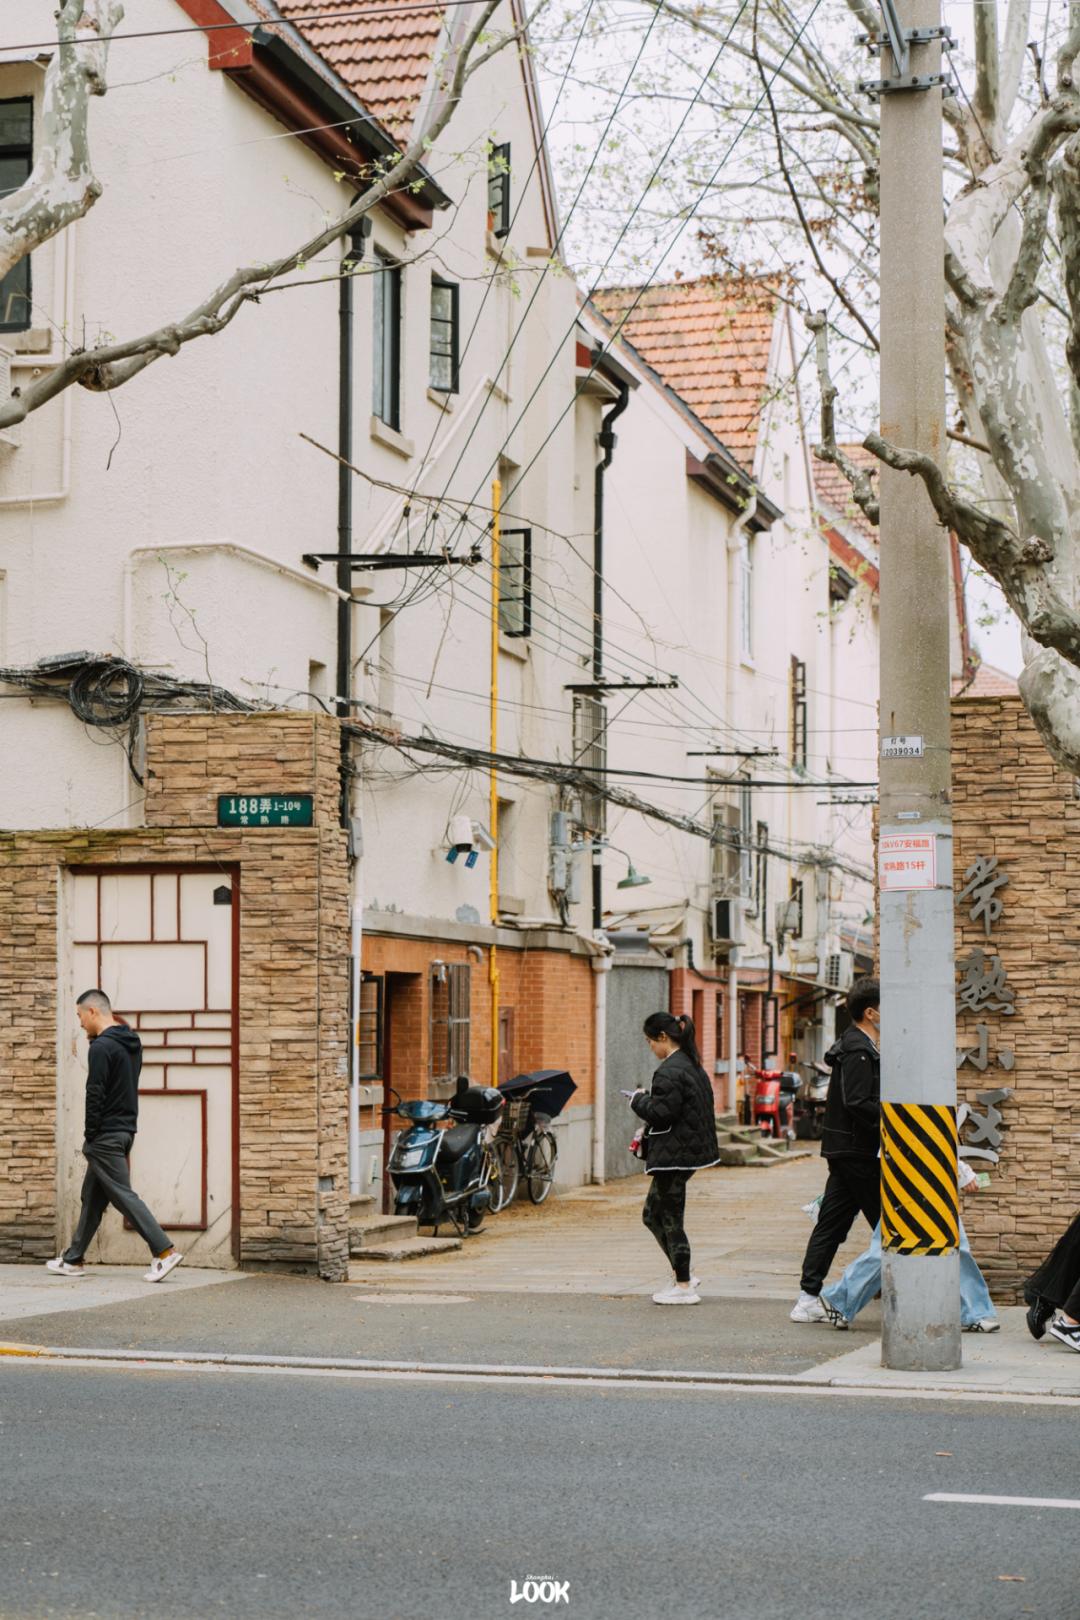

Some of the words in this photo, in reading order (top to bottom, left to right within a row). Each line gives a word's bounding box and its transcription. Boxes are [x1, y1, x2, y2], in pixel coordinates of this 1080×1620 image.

[229, 798, 272, 814] 188弄
[954, 853, 1018, 1165] 常熟小区
